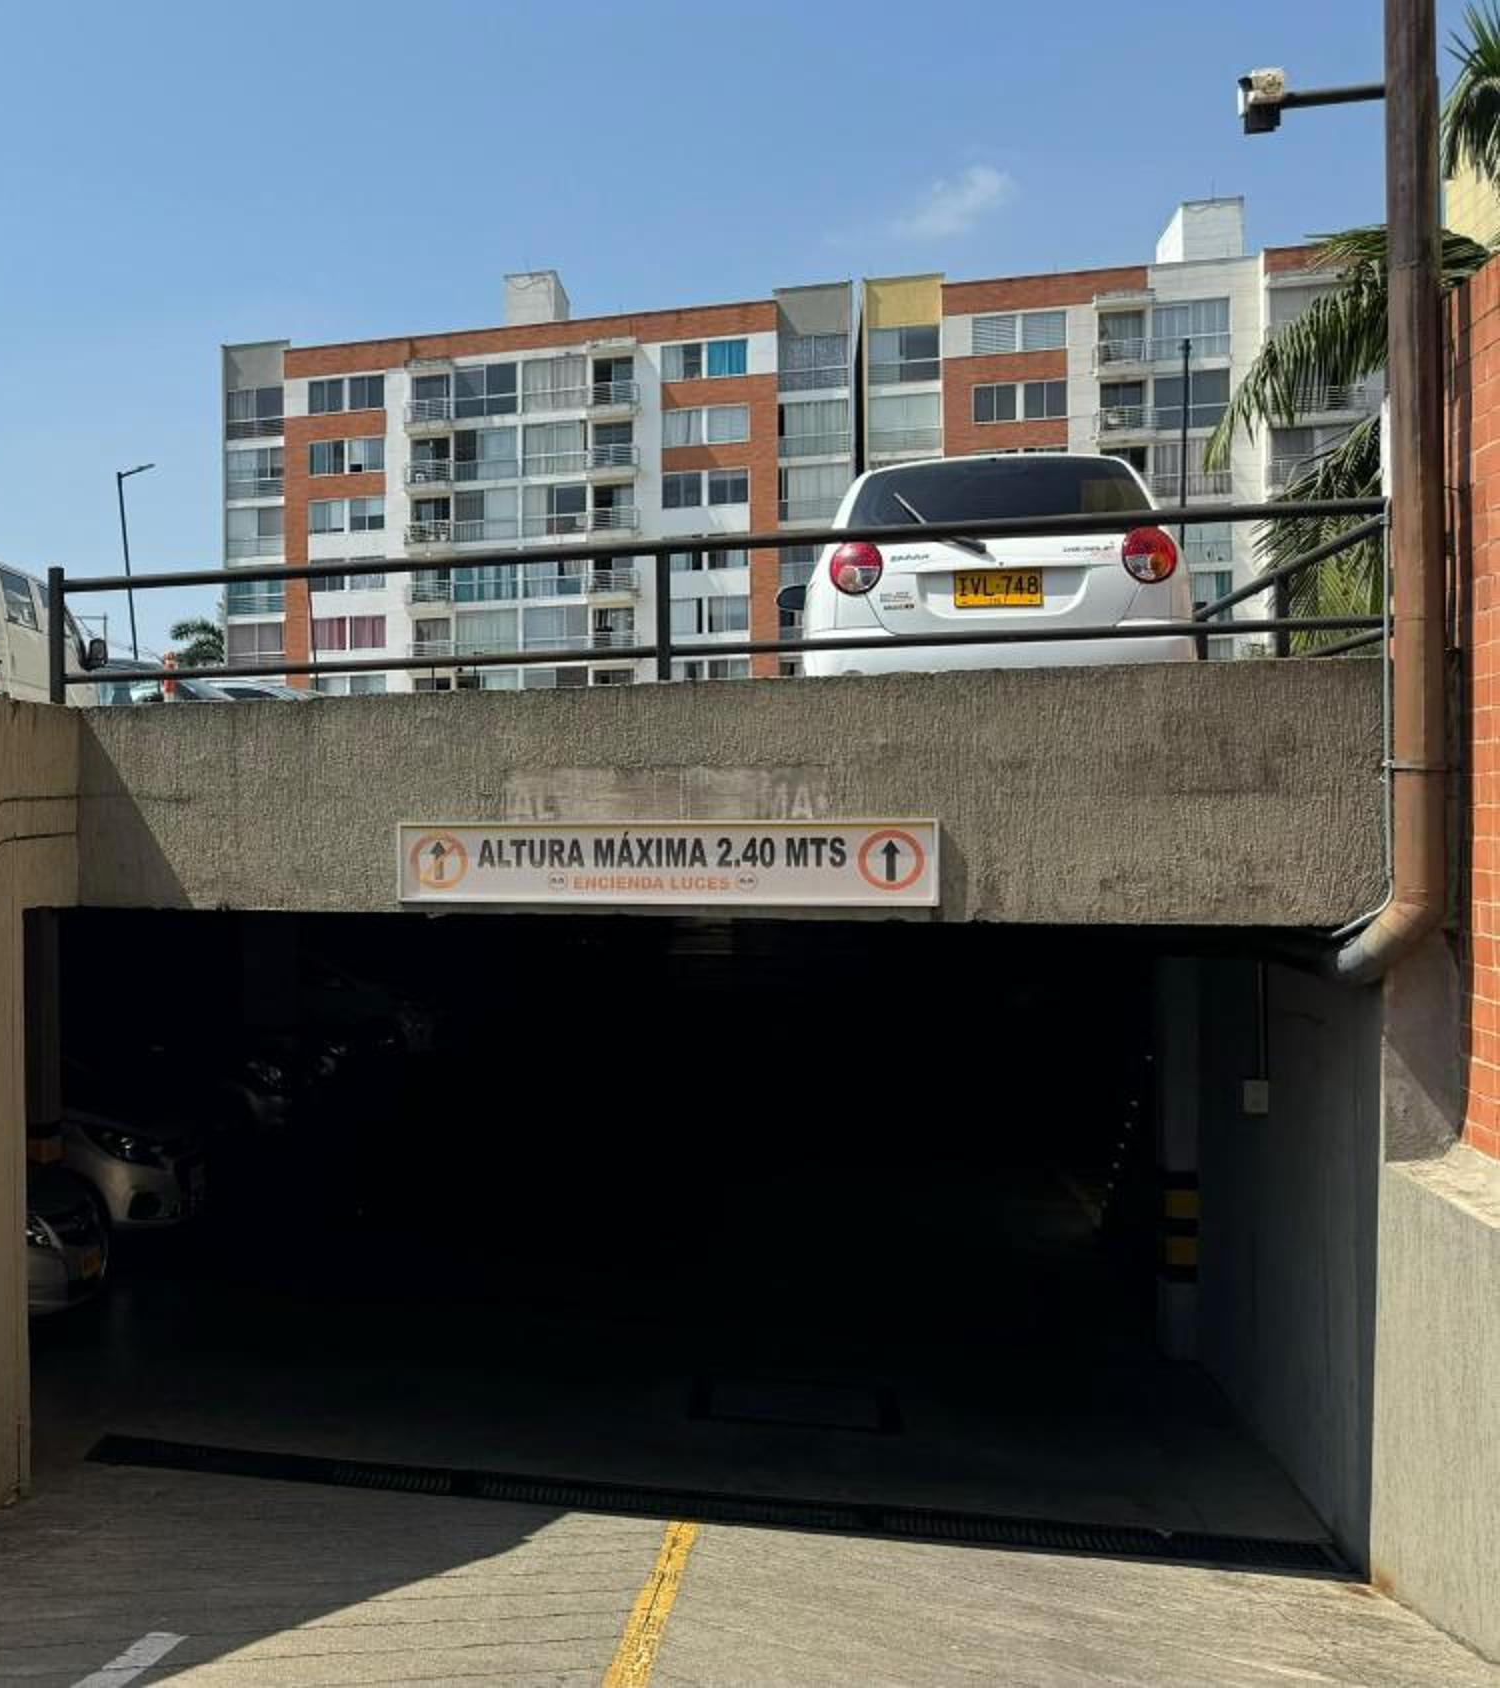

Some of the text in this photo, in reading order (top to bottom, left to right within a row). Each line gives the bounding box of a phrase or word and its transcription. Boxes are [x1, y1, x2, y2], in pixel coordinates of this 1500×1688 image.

[478, 831, 847, 868] ALTURA MÁXIMA 2.40 MTS
[573, 876, 731, 890] ENCIENDA LUCES
